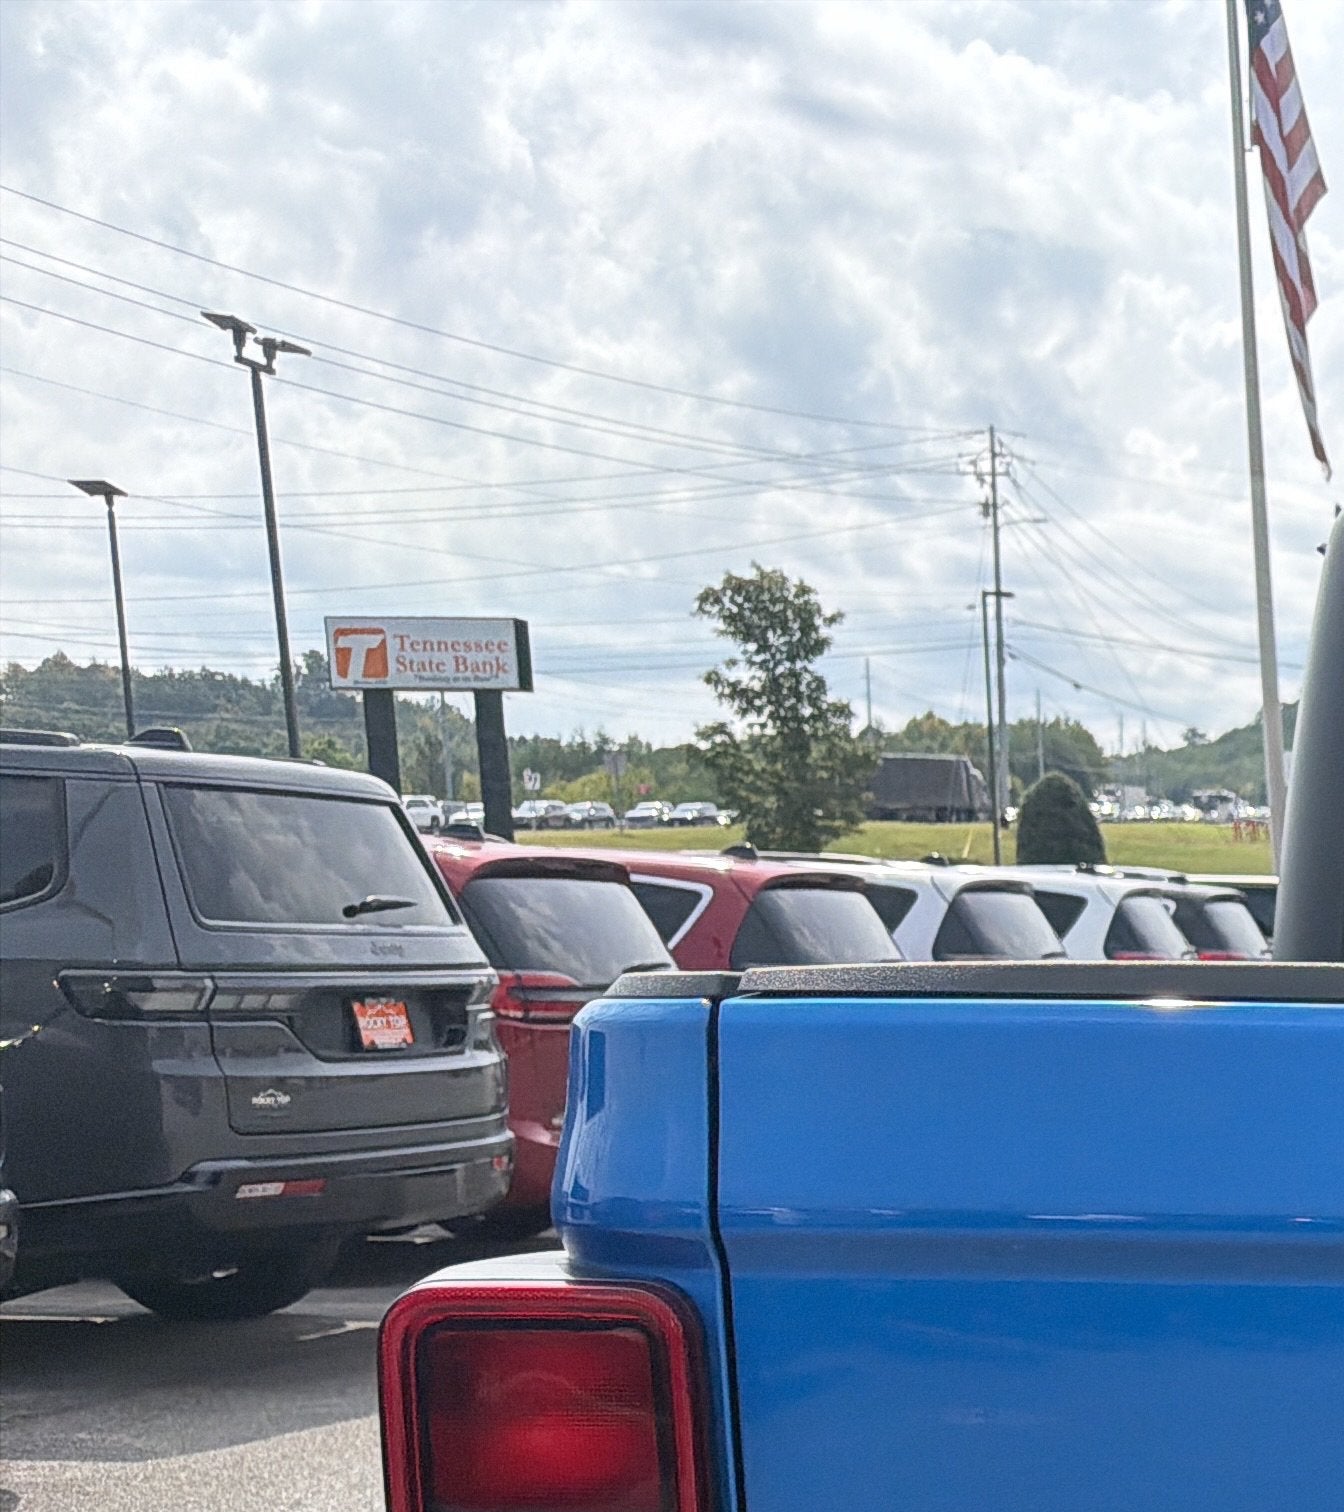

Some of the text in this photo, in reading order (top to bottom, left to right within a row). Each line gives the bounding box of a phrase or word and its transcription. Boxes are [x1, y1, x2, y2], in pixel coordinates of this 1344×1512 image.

[393, 634, 510, 653] Tennessee
[395, 655, 509, 674] State Bank
